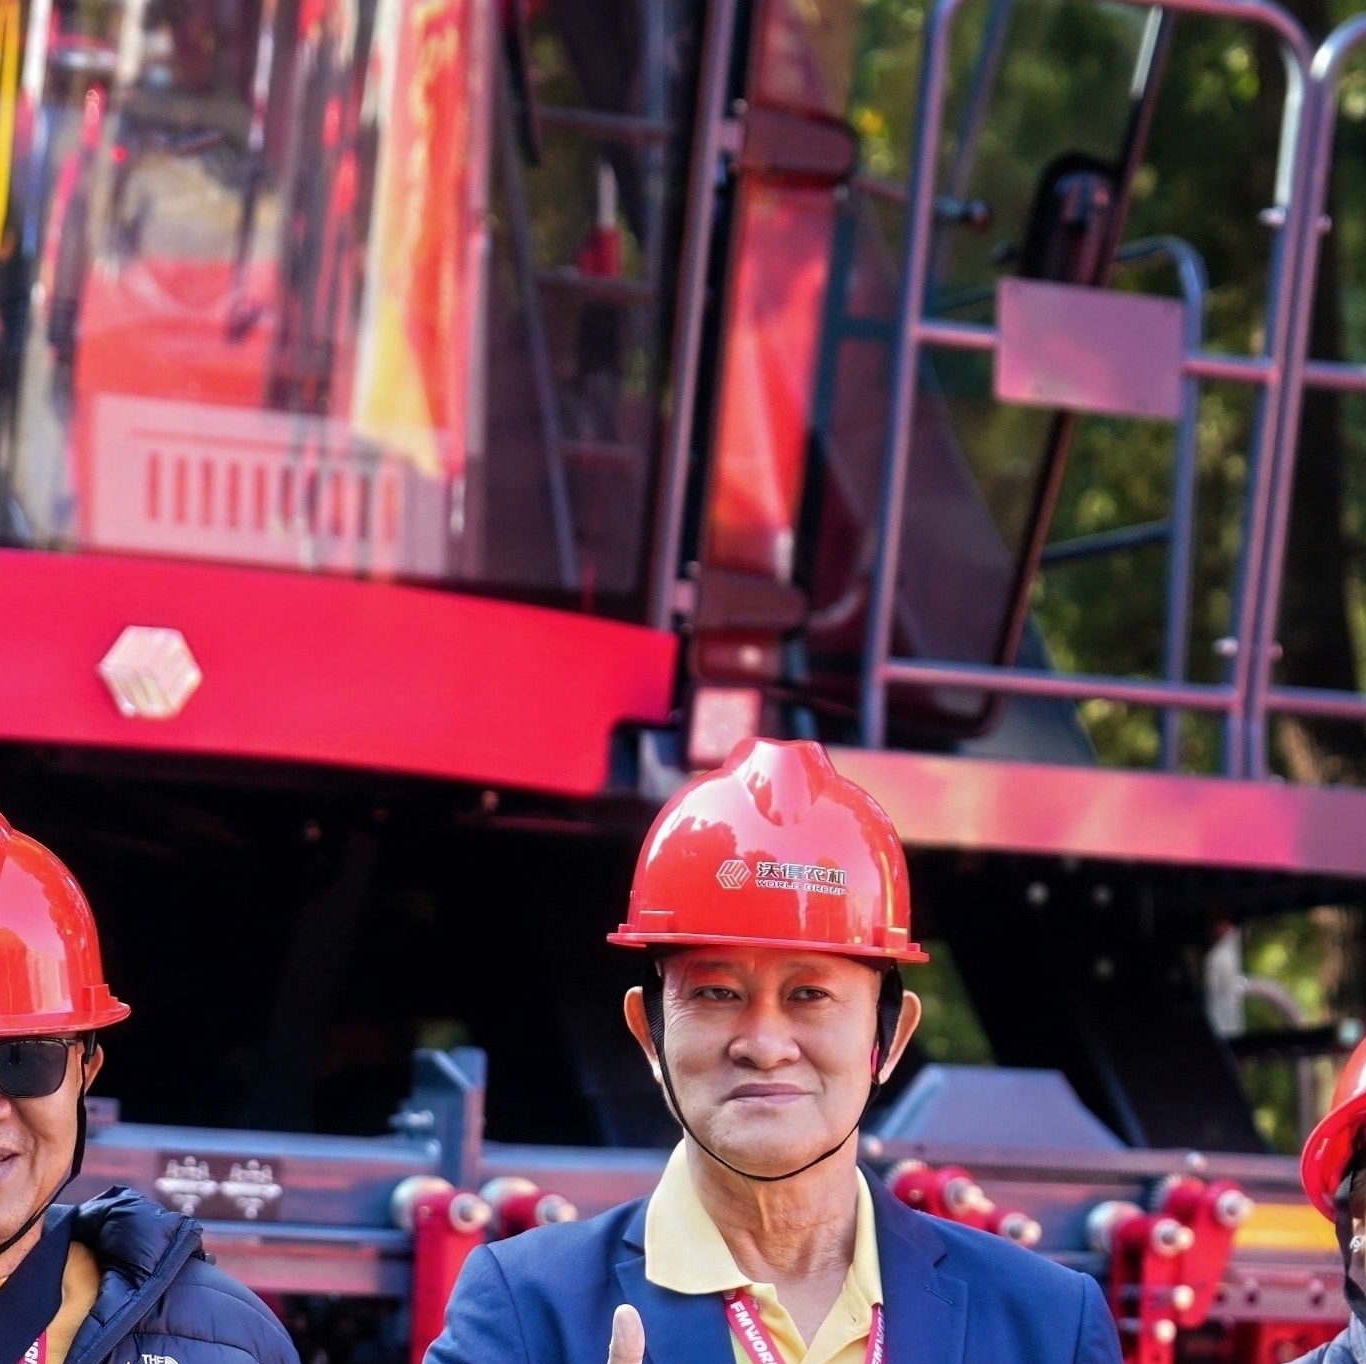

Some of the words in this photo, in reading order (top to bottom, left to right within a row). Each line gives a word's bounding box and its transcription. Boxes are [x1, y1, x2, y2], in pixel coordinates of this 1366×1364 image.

[757, 862, 847, 885] 沃得农机
[756, 880, 801, 889] WORLD
[804, 883, 847, 895] GROUP
